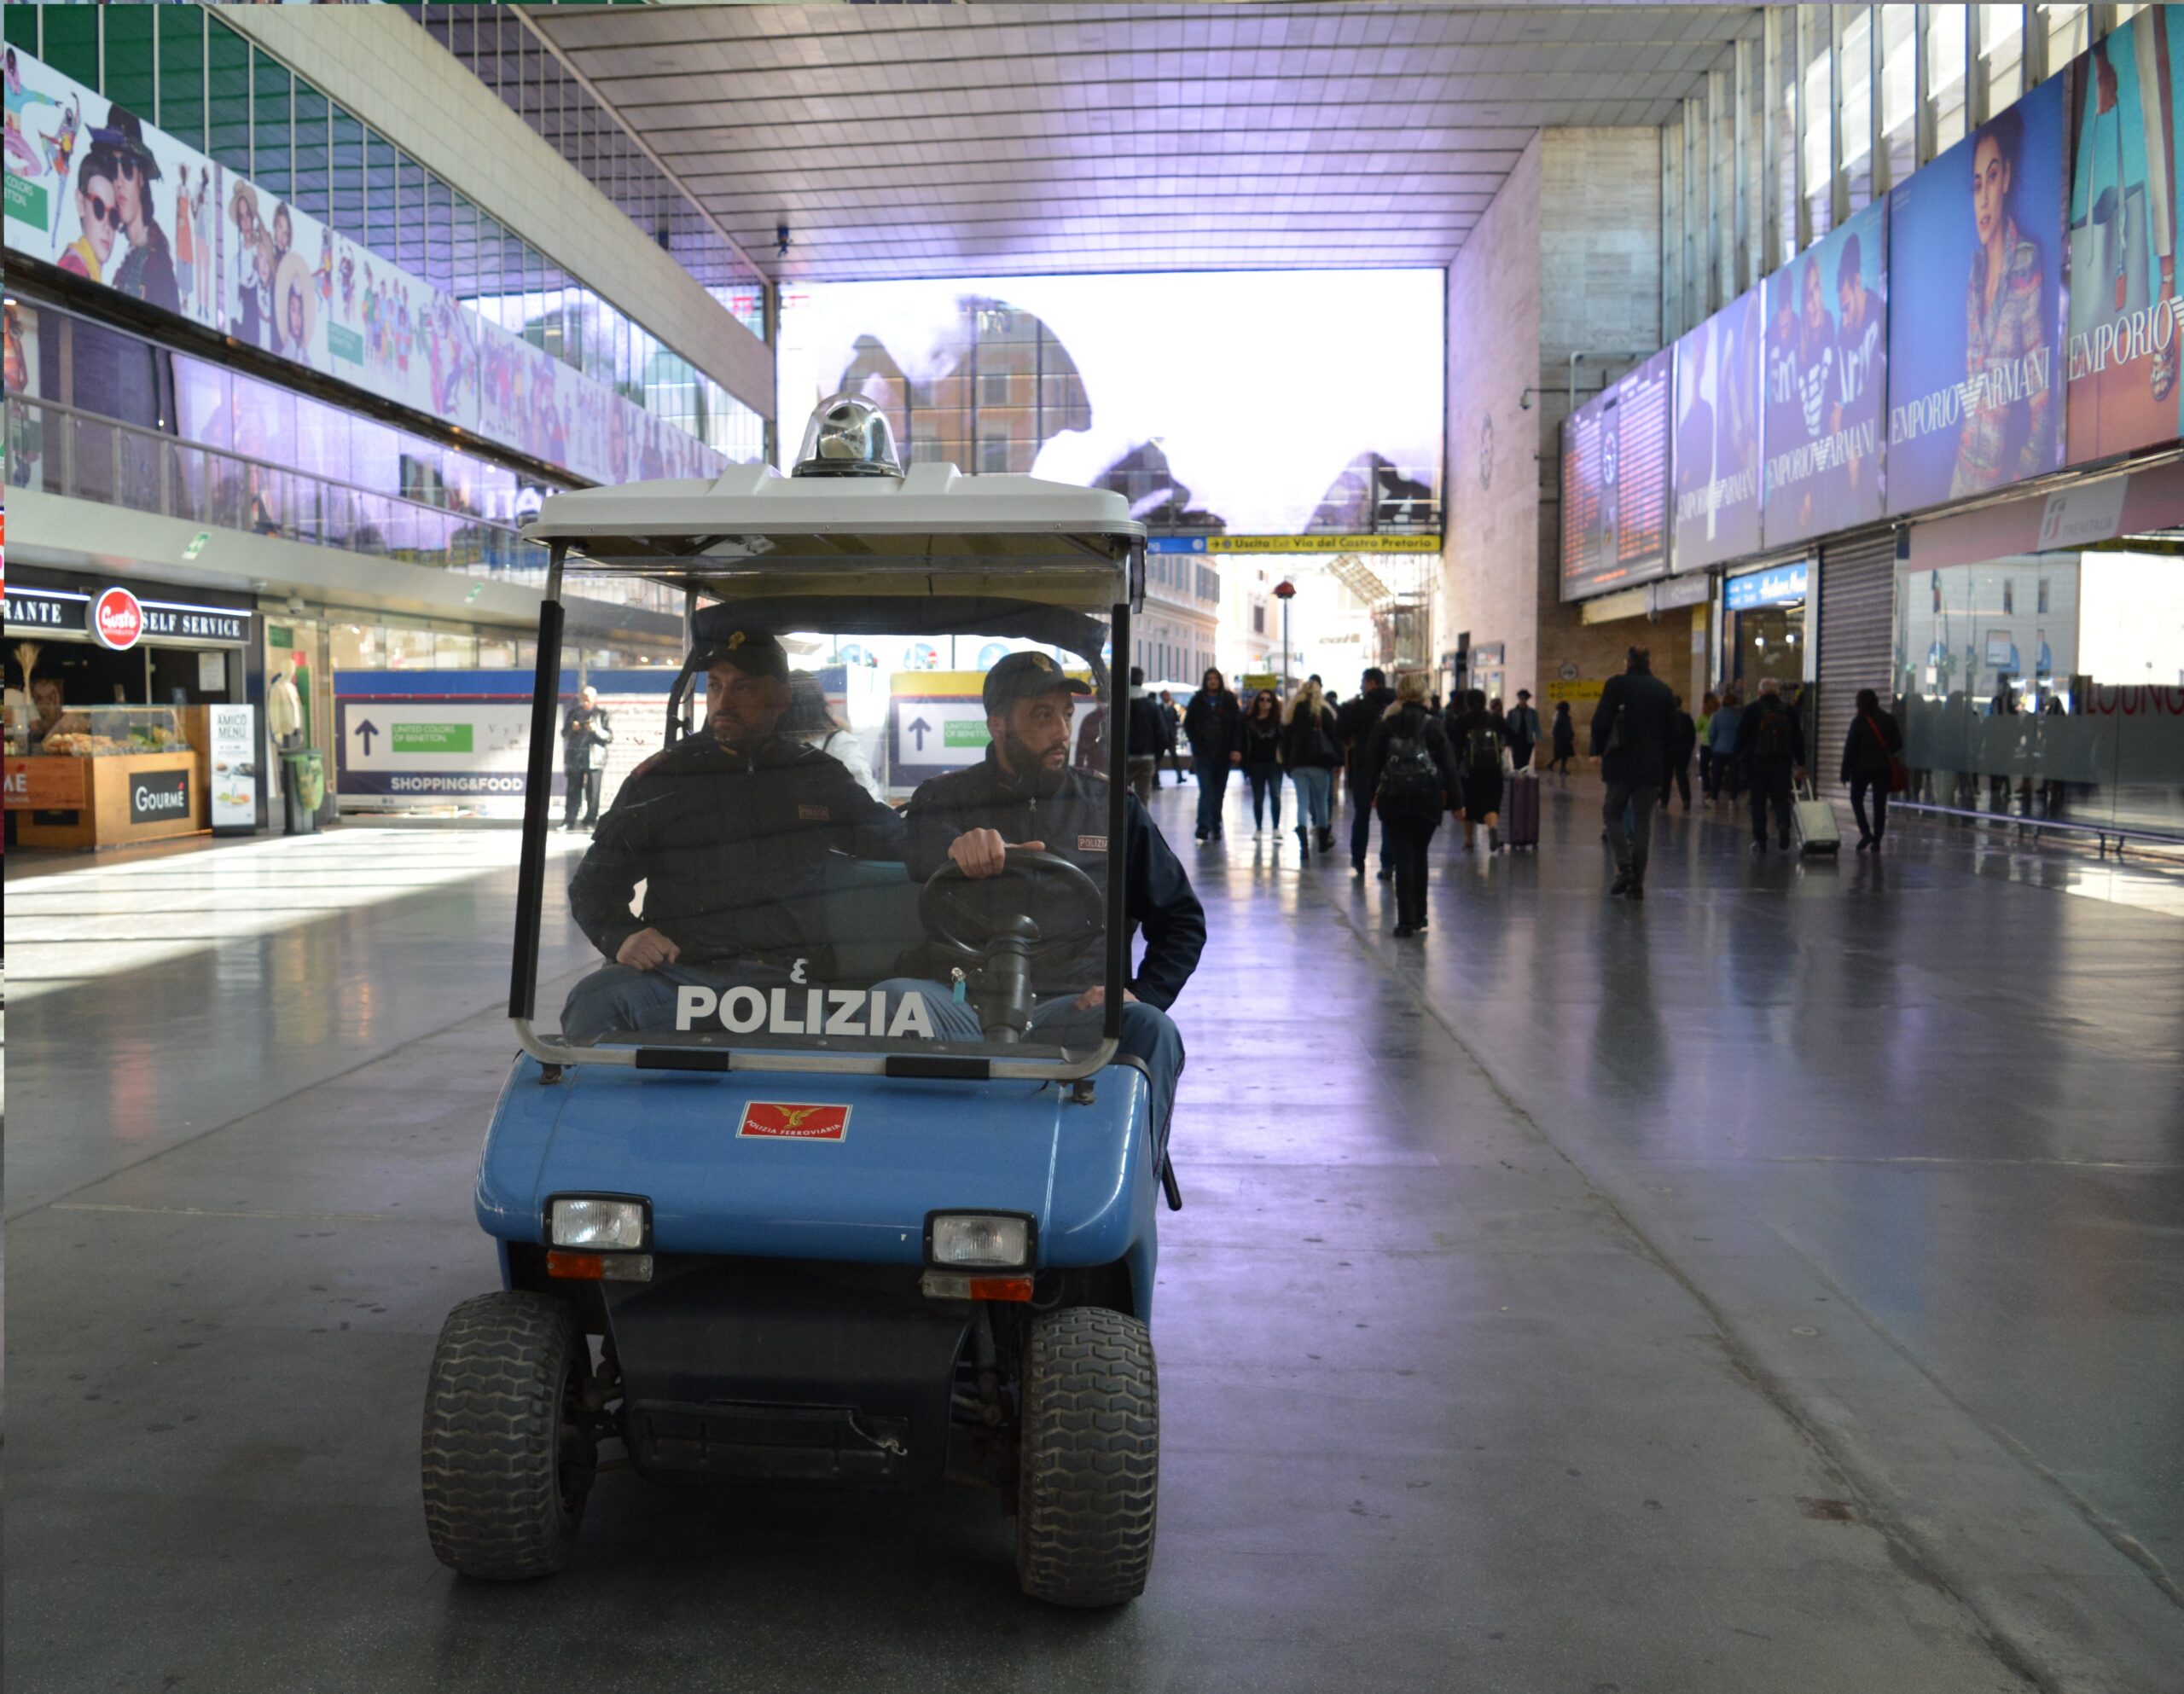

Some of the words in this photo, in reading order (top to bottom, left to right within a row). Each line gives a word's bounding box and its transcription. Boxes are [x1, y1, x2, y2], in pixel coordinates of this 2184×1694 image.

[2068, 300, 2173, 382] EMPORIO
[1891, 384, 1959, 445] EMPORIO
[1978, 346, 2051, 411] ARMANI
[1235, 538, 1269, 548] Uscita
[1293, 537, 1312, 548] Via
[1316, 537, 1335, 548] del
[1339, 537, 1378, 548] Castro
[1381, 537, 1432, 548] Pretorio
[183, 617, 241, 637] SERVICE
[392, 725, 422, 734] UNITED
[390, 776, 524, 792] SHOPPING&FOOD
[676, 985, 935, 1038] POLIZIA
[746, 1119, 777, 1135] POLIZIA
[780, 1123, 842, 1136] FERROVIARIA
